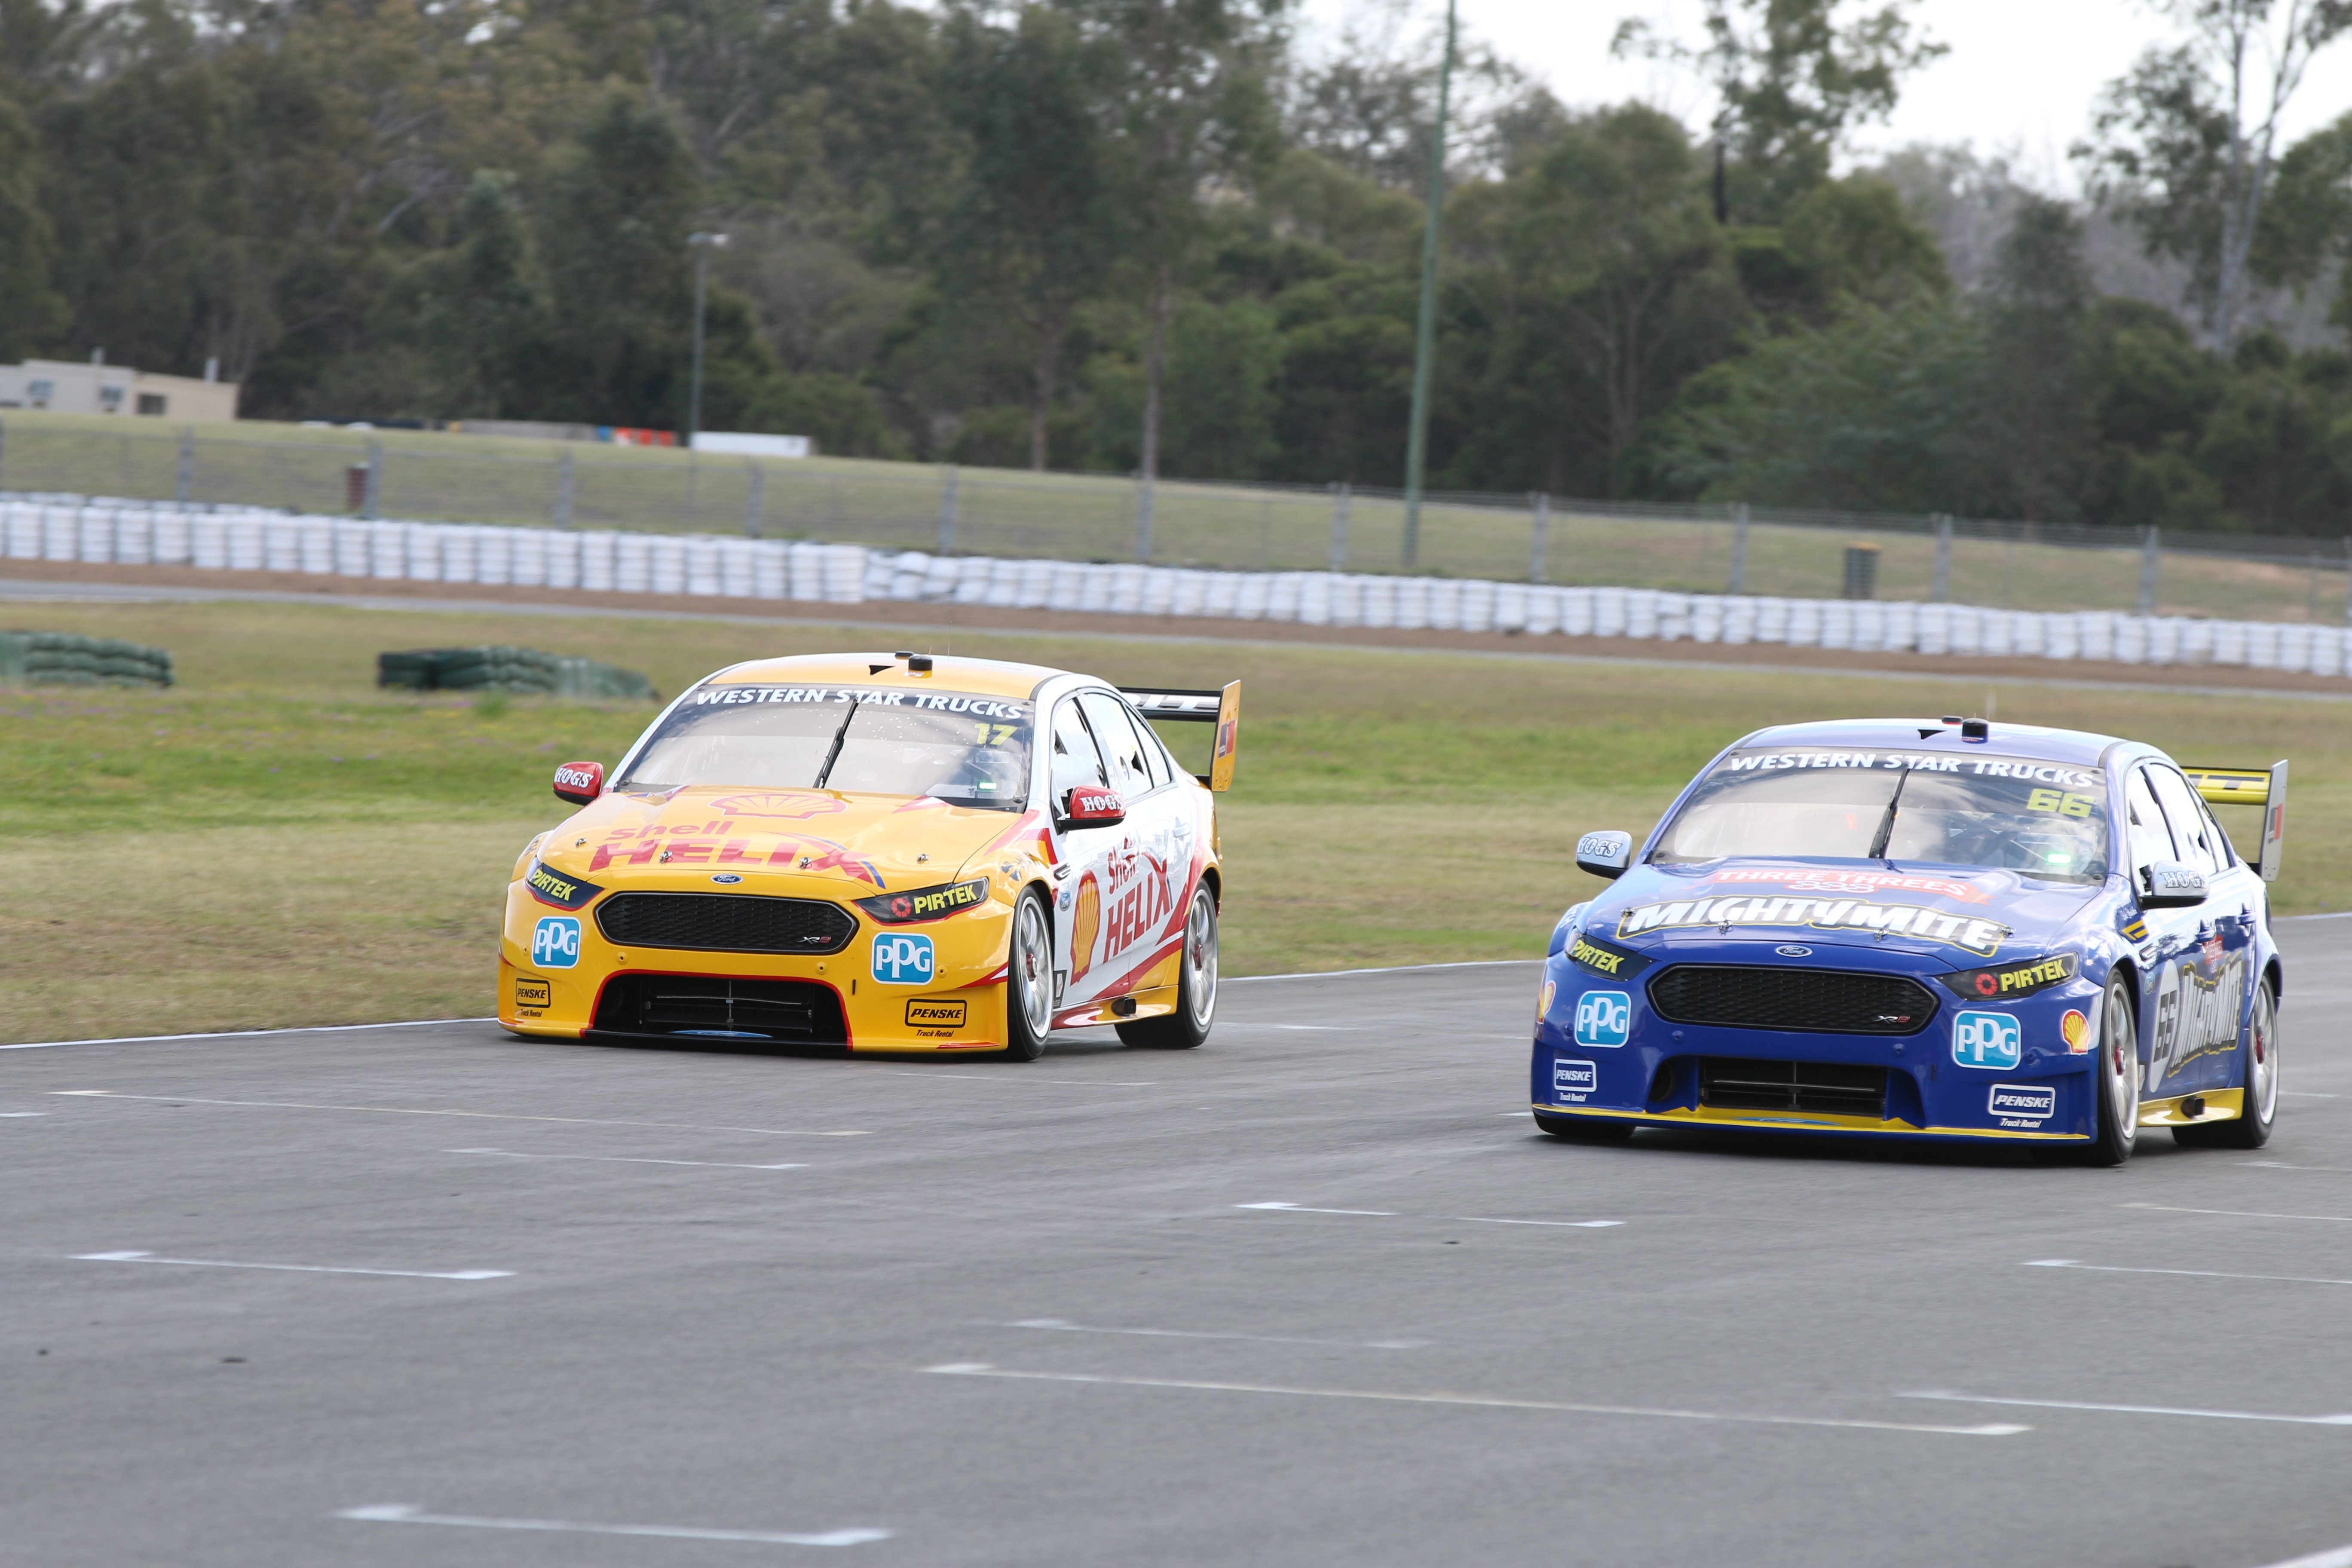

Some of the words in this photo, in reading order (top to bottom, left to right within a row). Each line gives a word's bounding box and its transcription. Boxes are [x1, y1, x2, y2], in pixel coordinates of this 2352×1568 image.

[696, 688, 827, 705] WESTERN
[833, 689, 905, 706] STAR
[914, 694, 1023, 720] TRUCKS
[975, 723, 1019, 744] 17
[1731, 753, 1874, 771] WESTERN
[1885, 755, 1961, 772] STAR
[1975, 760, 2093, 787] TRUCKS
[2027, 789, 2095, 818] 66
[589, 838, 875, 881] HELIX
[530, 869, 577, 901] PIRTEK
[1720, 872, 1828, 881] THREE
[1837, 874, 1967, 896] THREES
[913, 884, 977, 914] PIRTEK
[1104, 852, 1170, 964] HELIX
[1627, 897, 2000, 950] MIGHTYMITE
[1571, 940, 1625, 974] PIRTEK
[2000, 960, 2067, 991] PIRTEK
[518, 988, 546, 998] PENSKE
[910, 1008, 963, 1020] PENSKE
[1556, 1069, 1592, 1081] PENSKE
[1560, 1093, 1571, 1101] Truck
[1572, 1093, 1586, 1102] Rental
[1995, 1094, 2050, 1107] PENSKE
[2000, 1118, 2020, 1127] Truck
[2021, 1120, 2041, 1128] Rental
